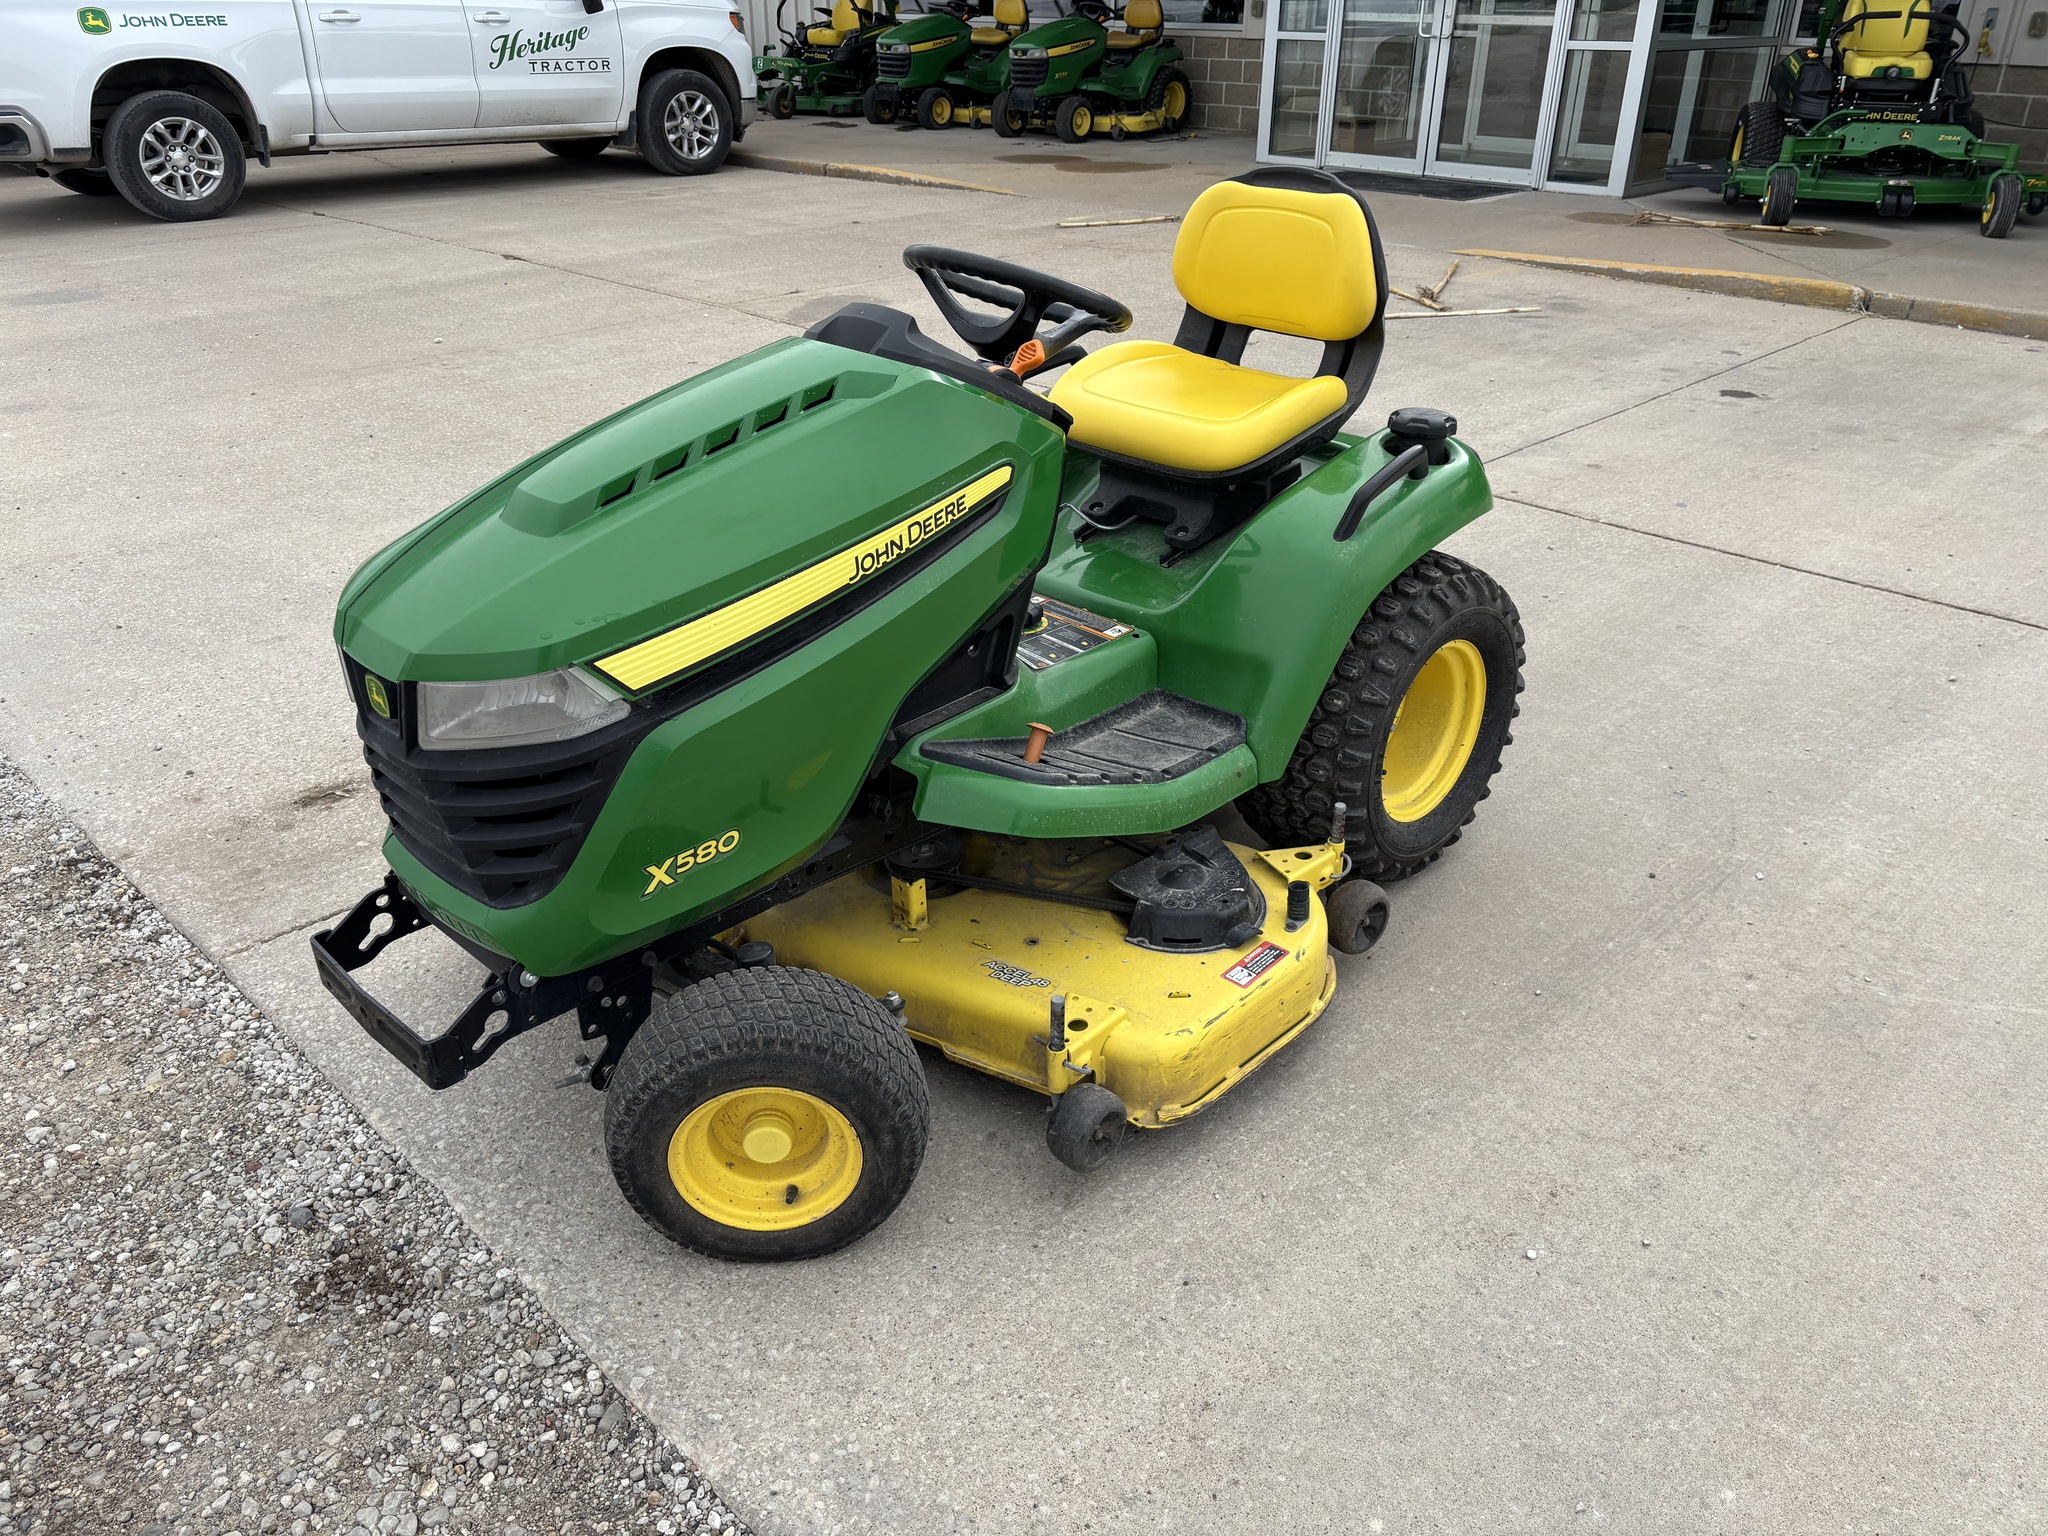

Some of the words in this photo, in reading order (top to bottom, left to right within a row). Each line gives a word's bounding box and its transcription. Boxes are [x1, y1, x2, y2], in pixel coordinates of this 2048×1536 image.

[119, 14, 168, 28] JOHN
[169, 13, 228, 27] DEERE
[489, 26, 591, 70] Heritage
[528, 60, 611, 72] TRACTOR
[1883, 111, 1919, 121] DEERE
[848, 534, 905, 582] JOHN
[907, 493, 968, 544] DEERE
[641, 828, 741, 898] X580
[982, 961, 1032, 981] ACCEL
[989, 970, 1034, 987] DEEP
